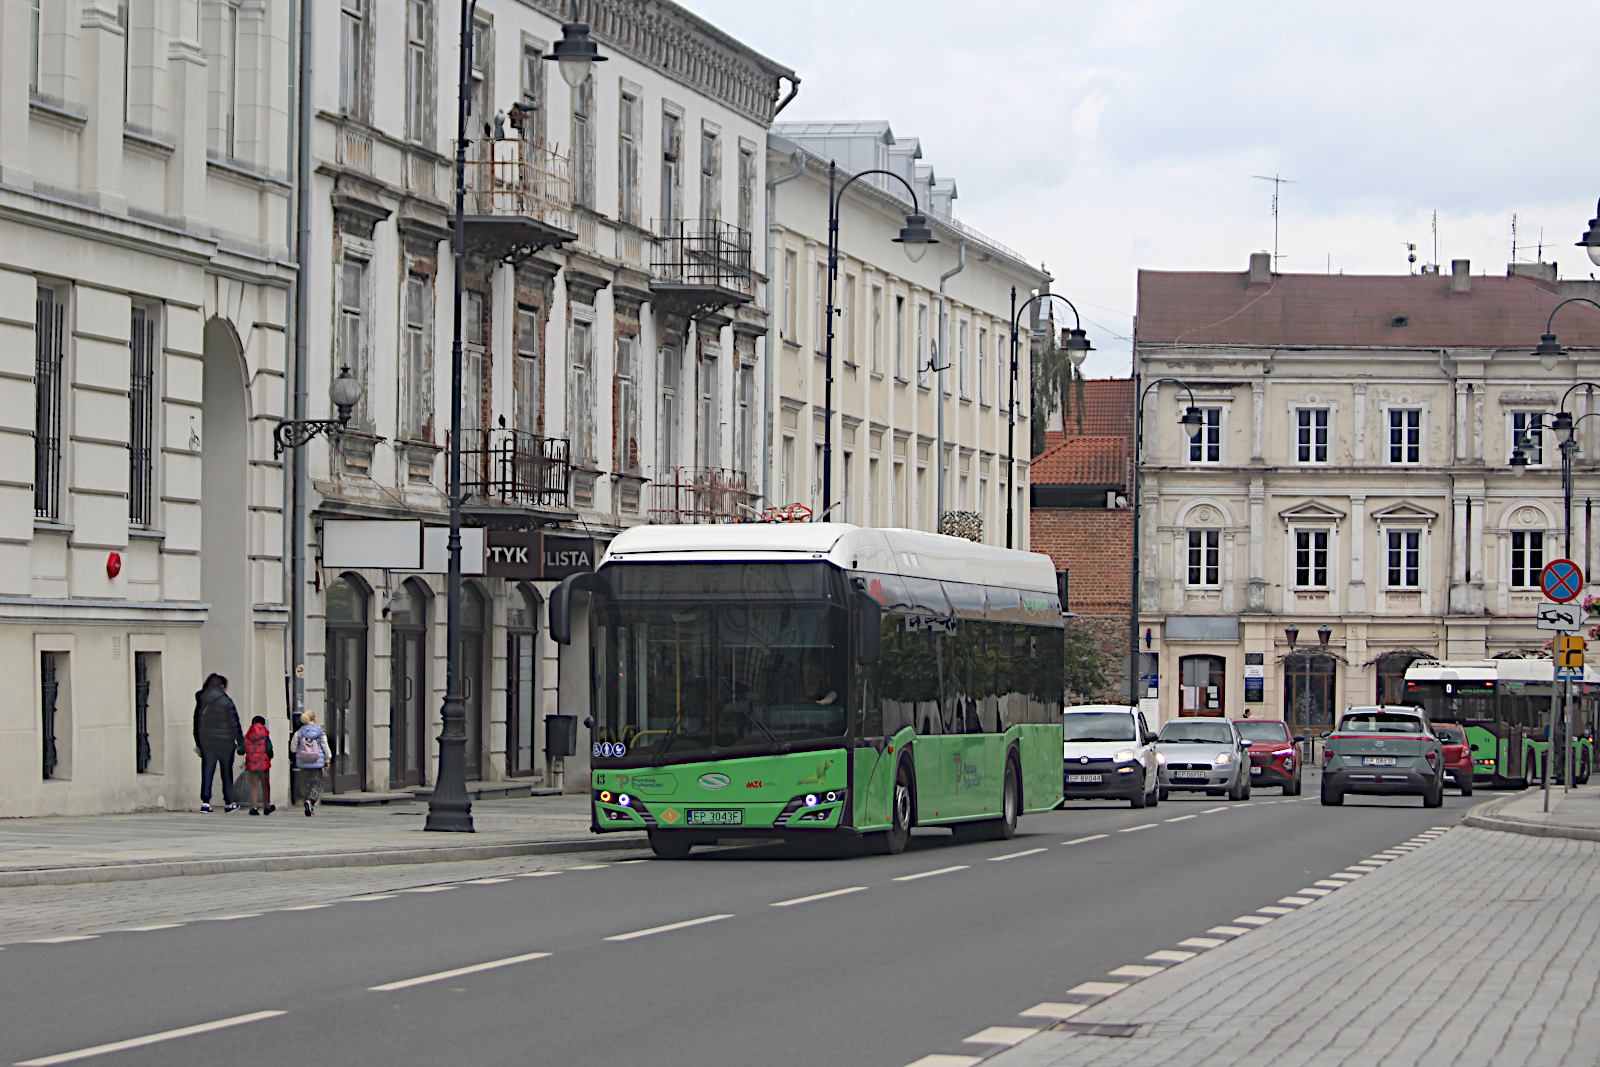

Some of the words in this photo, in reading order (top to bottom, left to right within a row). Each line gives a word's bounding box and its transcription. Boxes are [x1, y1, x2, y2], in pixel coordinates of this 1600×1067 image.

[544, 551, 590, 566] LISTA
[595, 774, 606, 785] 43
[1069, 775, 1079, 783] EP
[693, 811, 706, 821] EP
[709, 811, 739, 821] 3043F
